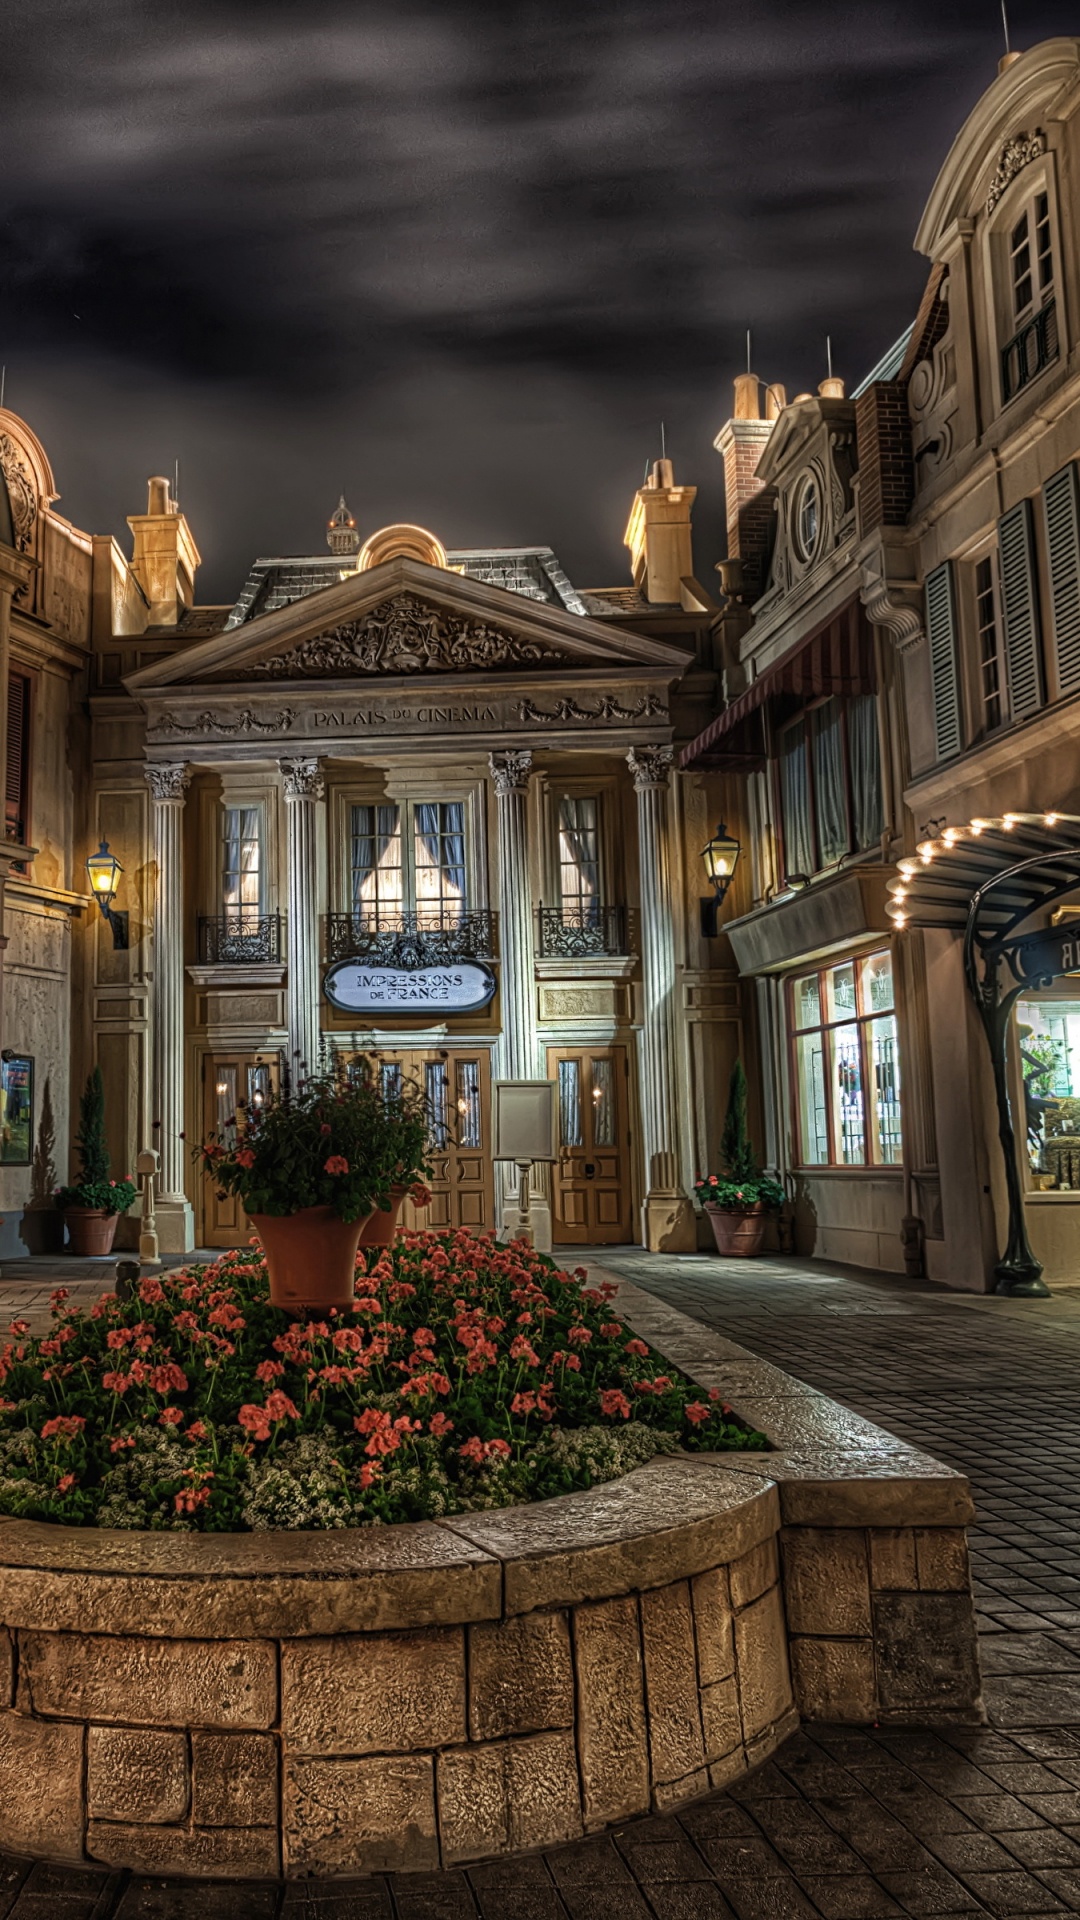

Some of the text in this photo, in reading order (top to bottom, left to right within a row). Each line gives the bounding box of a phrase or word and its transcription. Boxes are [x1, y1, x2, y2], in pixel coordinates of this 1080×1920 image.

[314, 706, 496, 727] PALAIS DU CINEMA
[357, 974, 463, 987] IMPRESSIONS
[370, 987, 449, 1000] DE FRANCE
